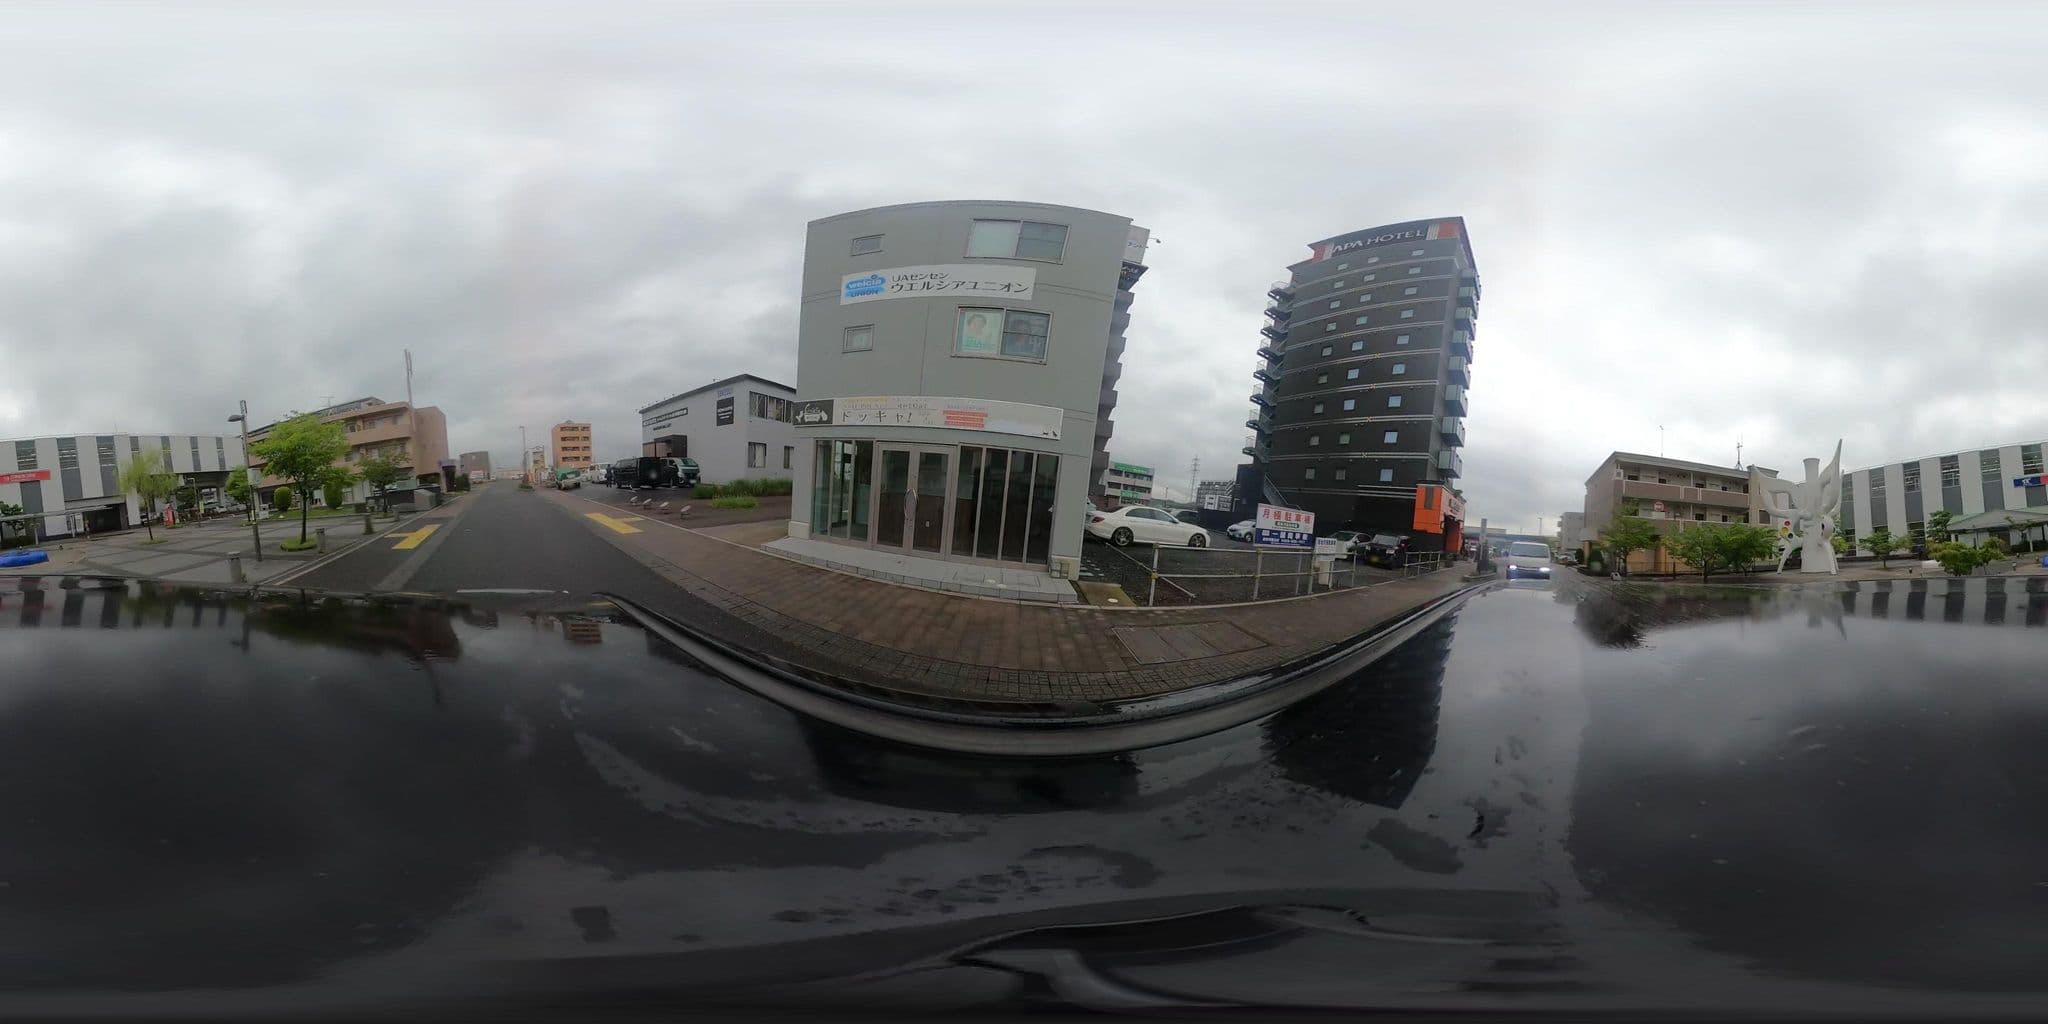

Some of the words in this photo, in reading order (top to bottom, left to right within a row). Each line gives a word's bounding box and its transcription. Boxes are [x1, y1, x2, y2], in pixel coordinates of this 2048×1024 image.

[1333, 240, 1363, 253] APA
[1367, 229, 1425, 246] HOTEL
[890, 280, 1031, 294] ウエルシアユニオン
